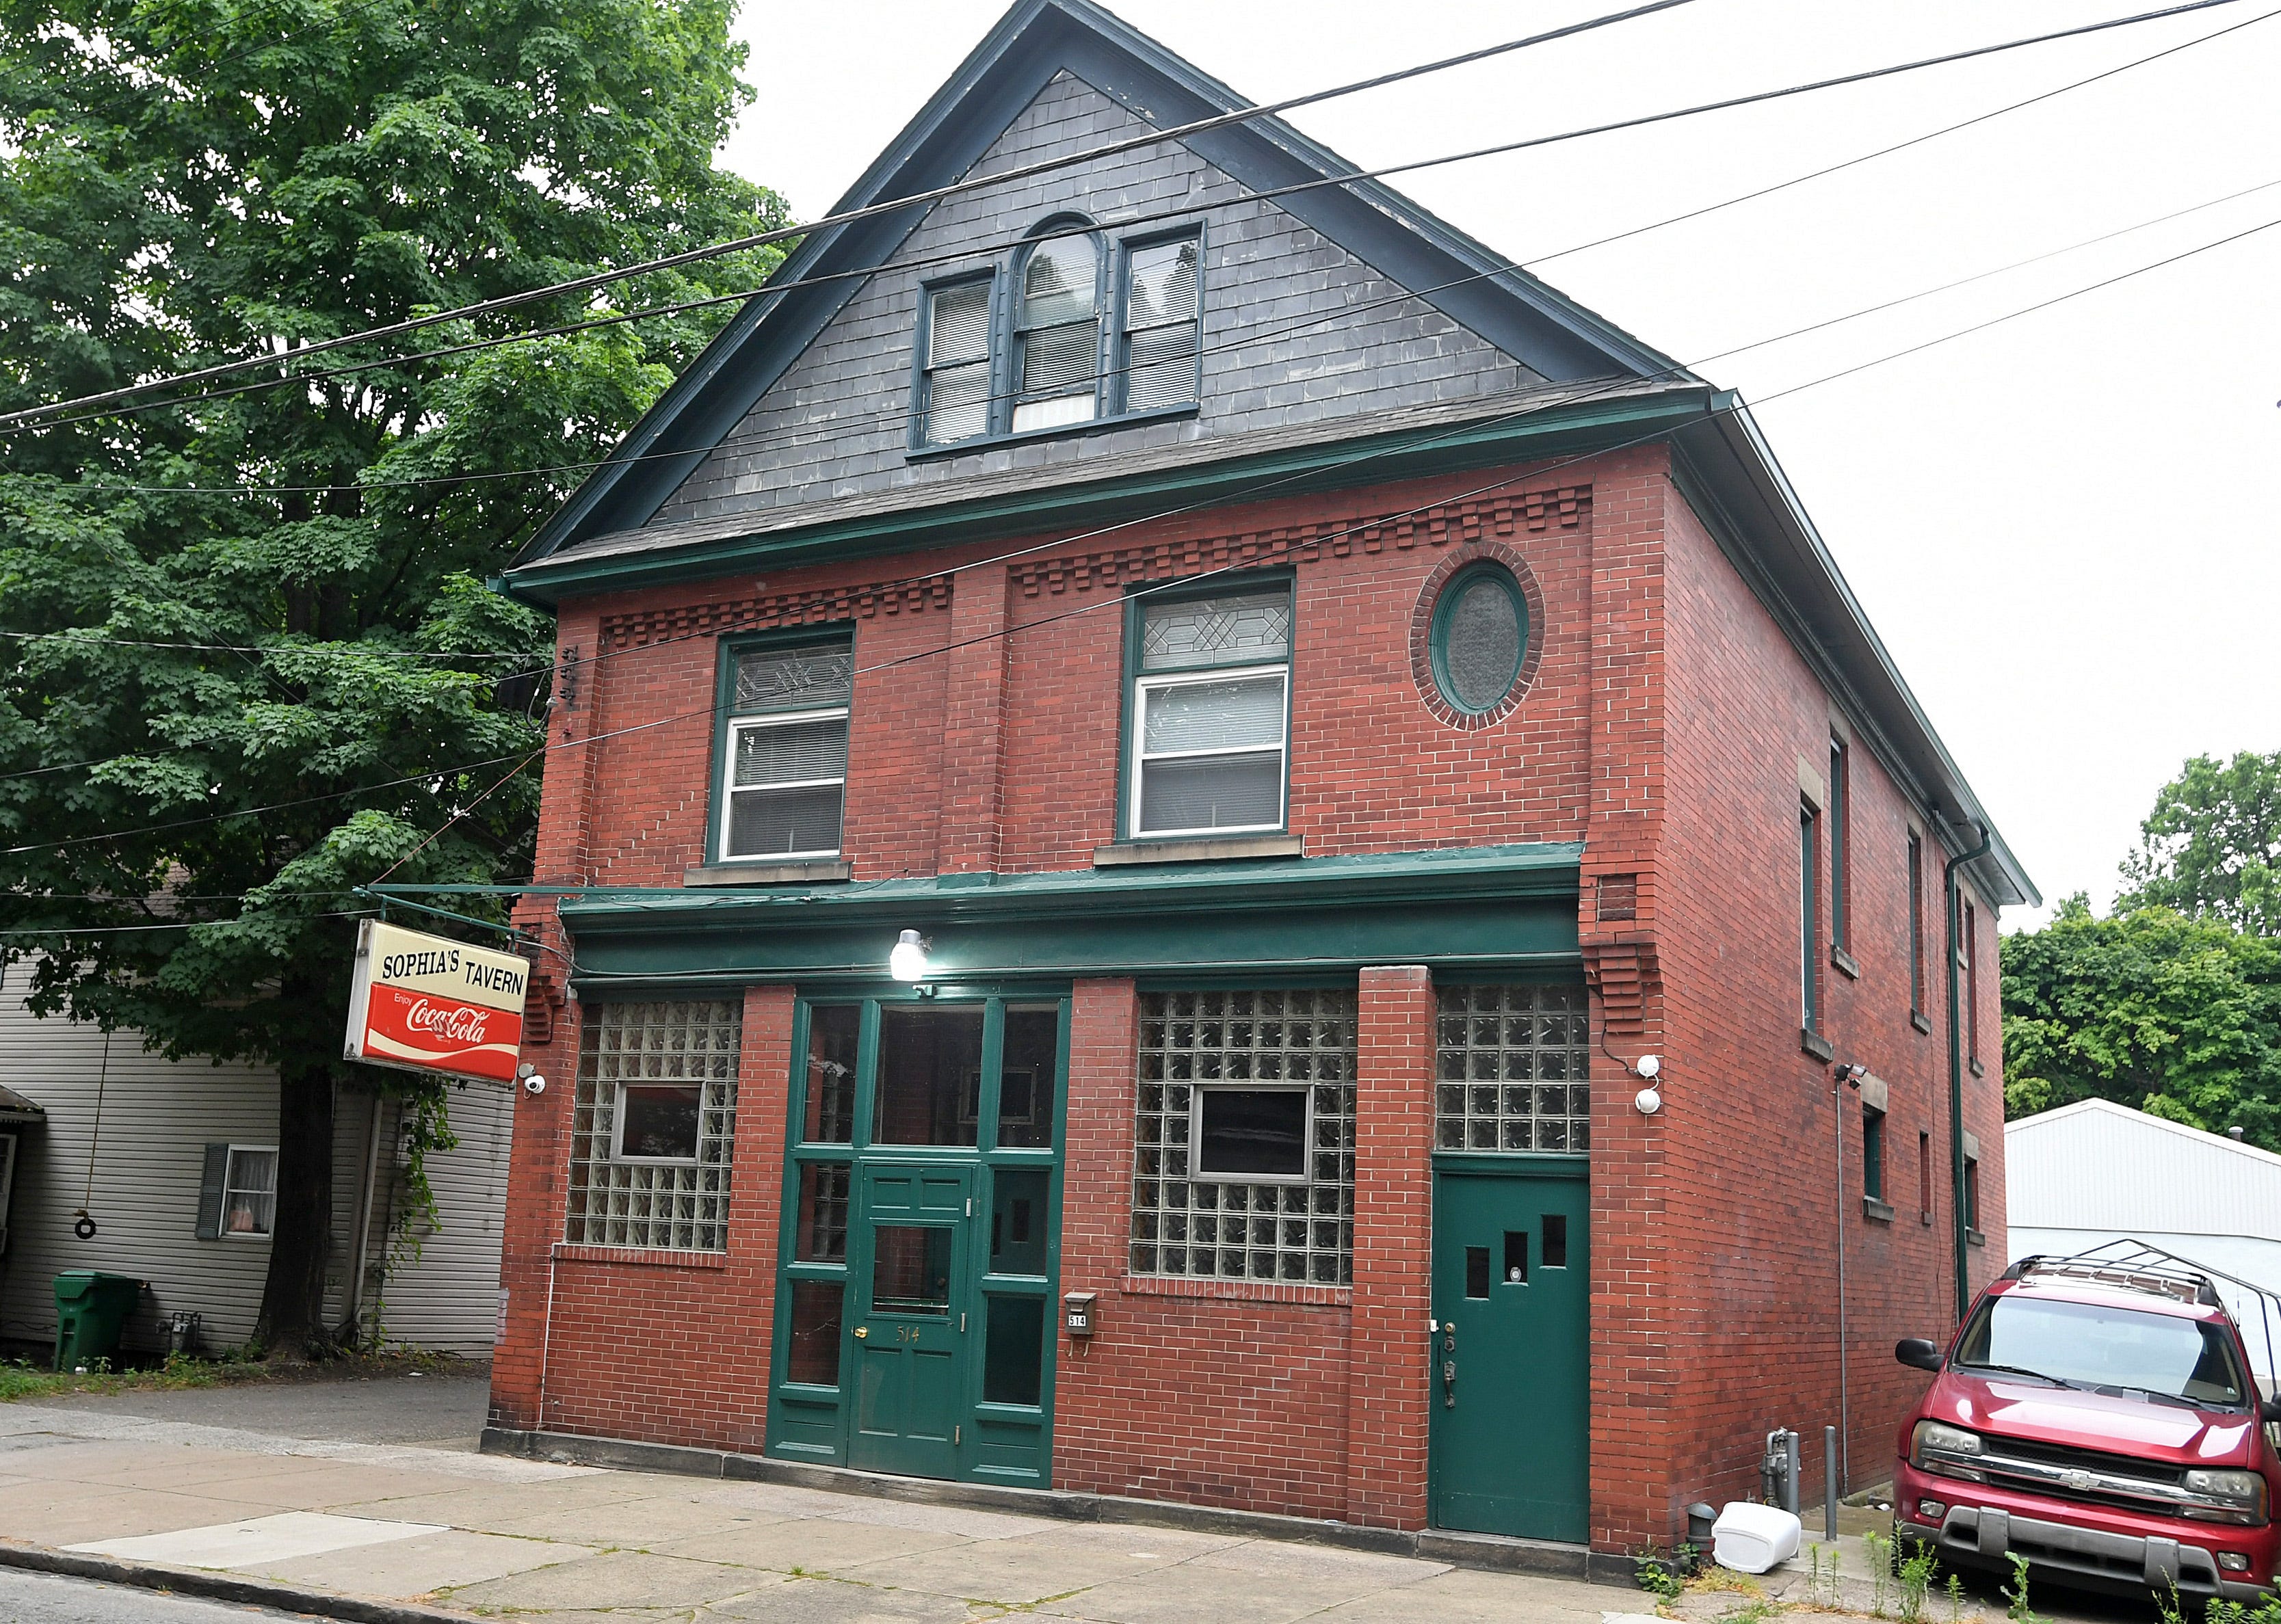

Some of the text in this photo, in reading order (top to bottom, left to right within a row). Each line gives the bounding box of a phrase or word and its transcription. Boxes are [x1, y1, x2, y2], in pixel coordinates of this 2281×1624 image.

[382, 949, 524, 996] SOPHIA'S TAVERN
[394, 993, 413, 1007] Enjoy
[406, 998, 491, 1043] Coca-Cola
[1070, 1316, 1085, 1326] 514
[896, 1326, 920, 1344] 514
